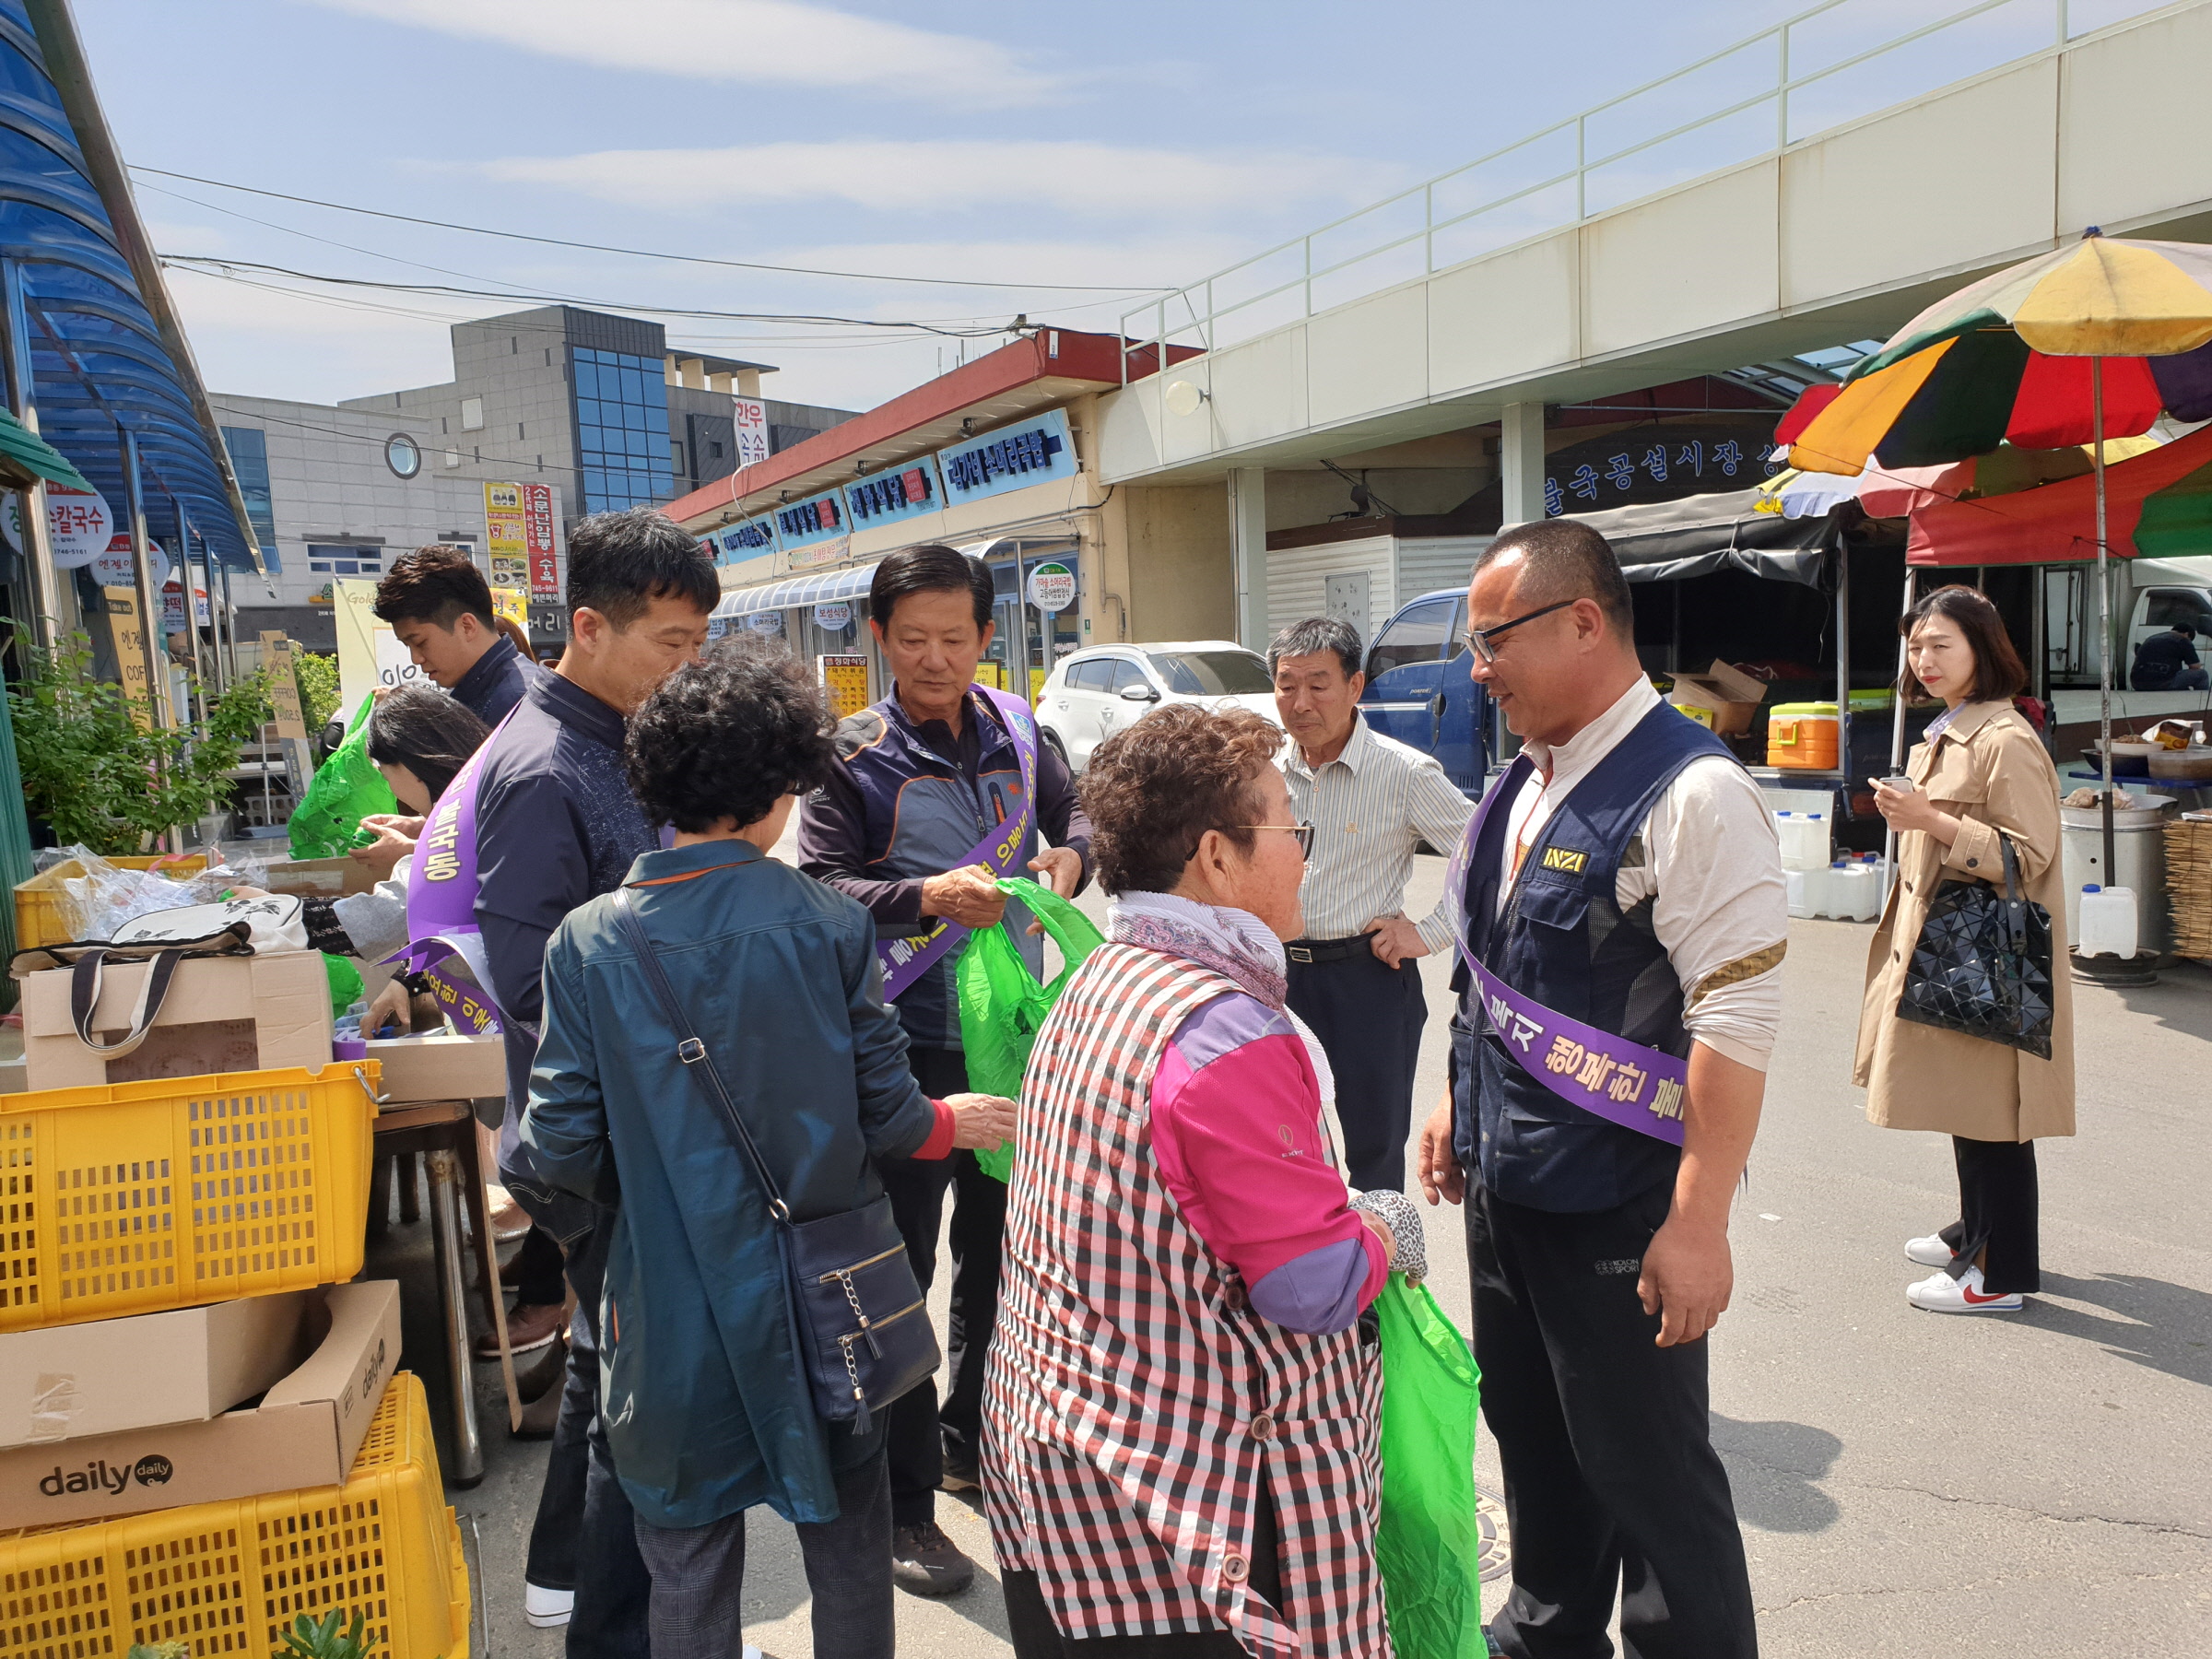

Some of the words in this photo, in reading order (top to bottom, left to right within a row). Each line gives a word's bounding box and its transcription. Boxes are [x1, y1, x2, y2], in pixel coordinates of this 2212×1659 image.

[736, 402, 762, 429] 한우
[985, 430, 1047, 476] 소머리국밥
[1050, 577, 1072, 587] 소머리국밥
[819, 607, 848, 618] 보성식당
[126, 665, 146, 680] COF
[1545, 1035, 1648, 1102] 행복한
[1613, 1258, 1640, 1266] KOLON
[40, 1460, 132, 1496] daily
[137, 1463, 170, 1476] daily
